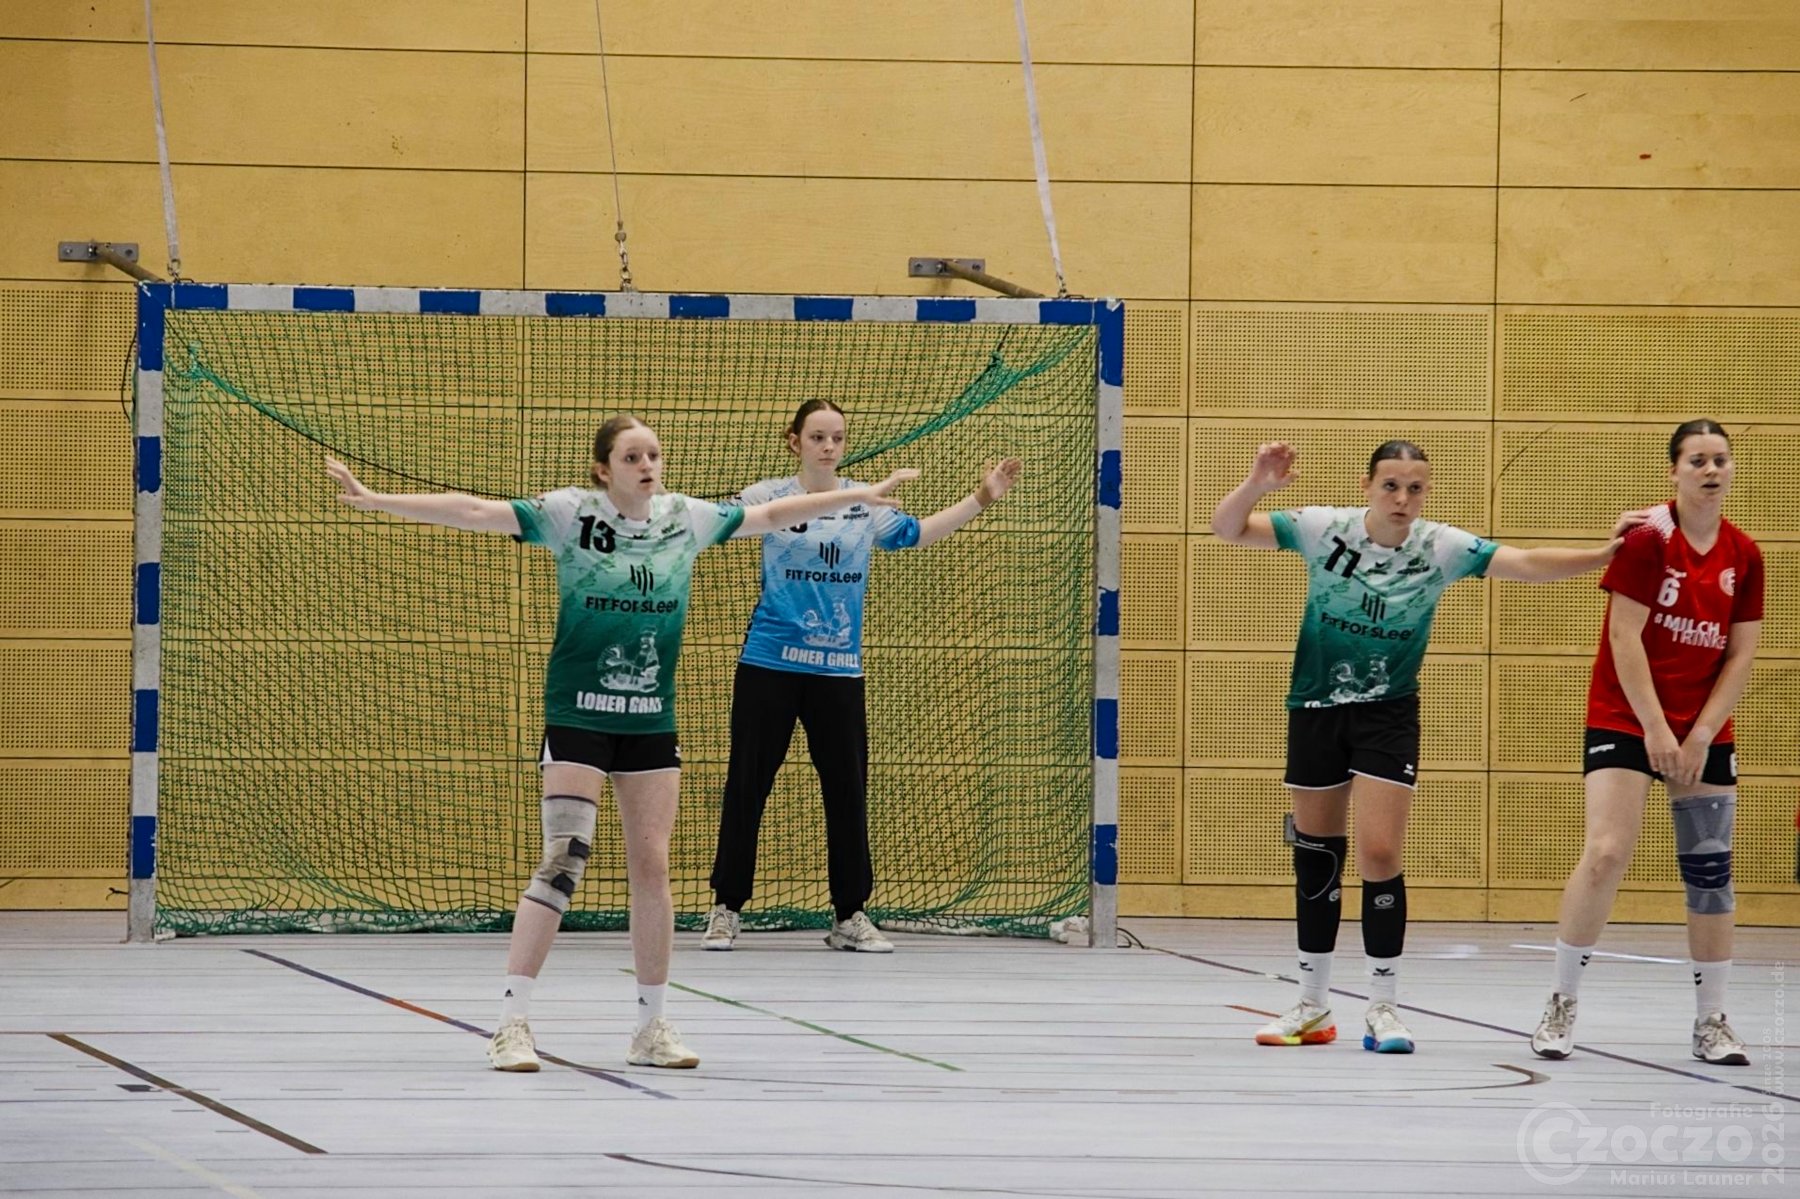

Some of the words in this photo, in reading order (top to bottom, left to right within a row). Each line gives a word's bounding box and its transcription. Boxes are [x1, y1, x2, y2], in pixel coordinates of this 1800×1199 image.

[578, 514, 616, 554] 13
[785, 568, 803, 581] FIT
[586, 596, 609, 611] FIT
[1656, 577, 1681, 608] 6
[781, 645, 825, 666] LOHER
[827, 651, 860, 669] GRILL
[576, 690, 627, 714] LOHER
